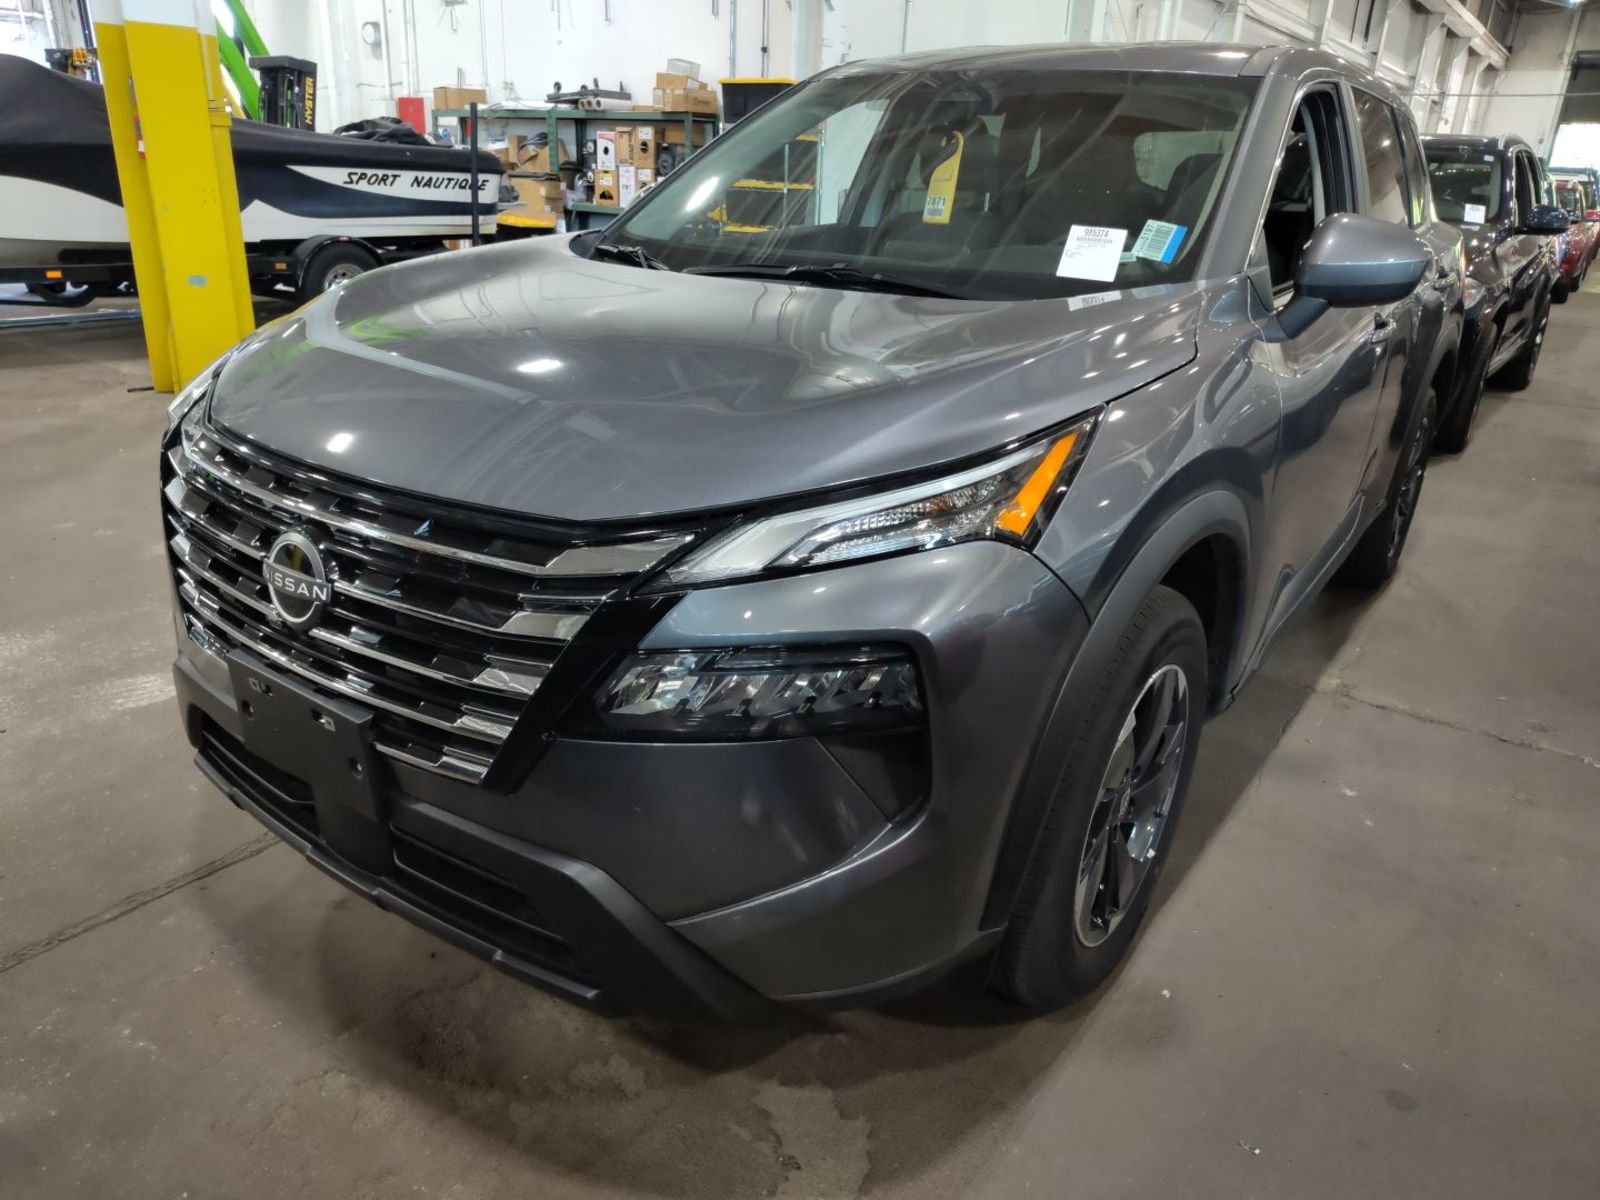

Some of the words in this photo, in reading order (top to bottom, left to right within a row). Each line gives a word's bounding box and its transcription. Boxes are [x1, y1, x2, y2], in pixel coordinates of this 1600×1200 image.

[305, 76, 314, 125] HYSTER
[343, 171, 401, 187] SPORT
[410, 175, 489, 191] NAUTIQE
[263, 563, 327, 601] NISSAN
